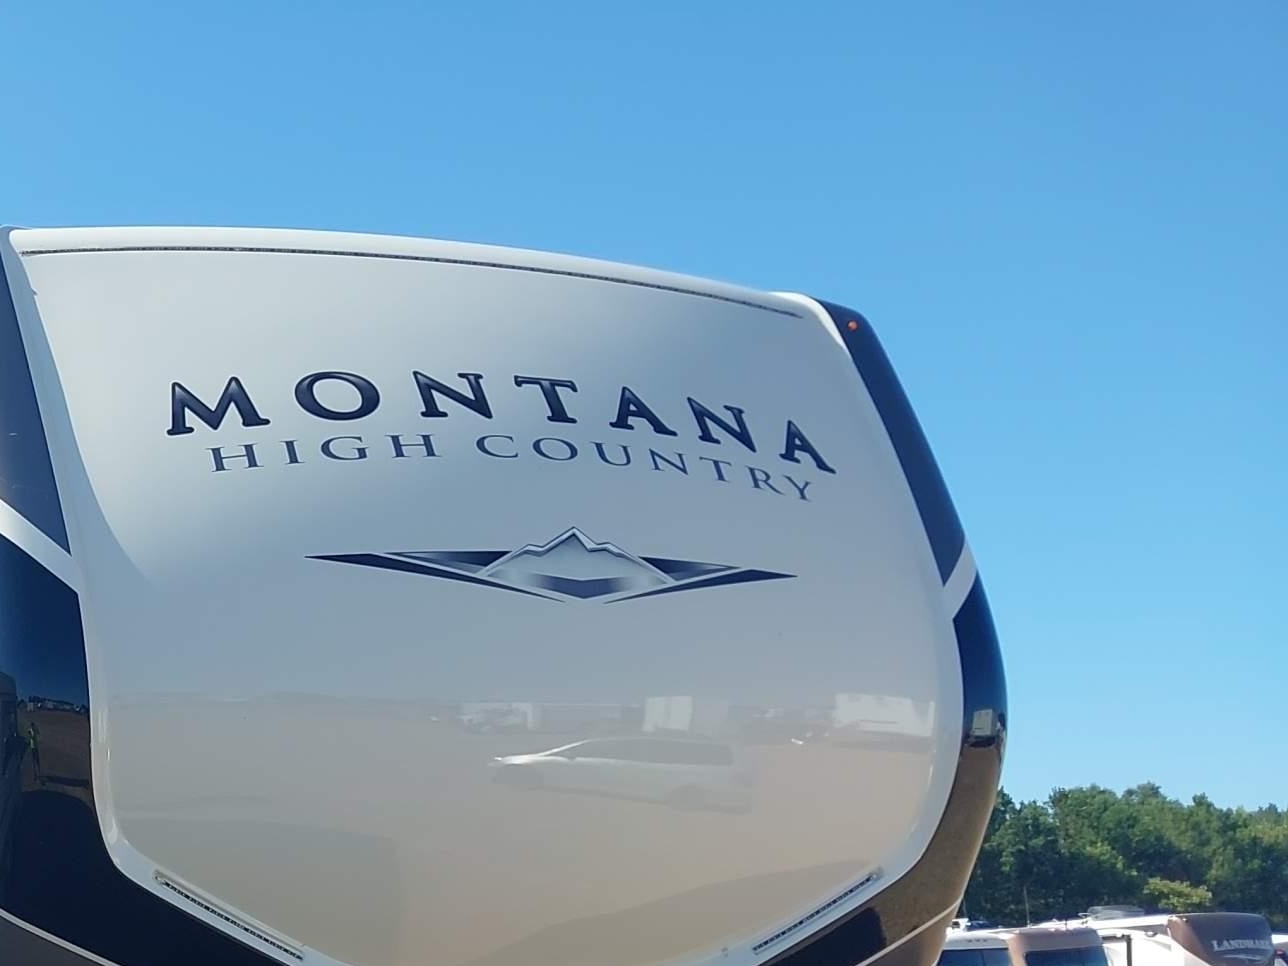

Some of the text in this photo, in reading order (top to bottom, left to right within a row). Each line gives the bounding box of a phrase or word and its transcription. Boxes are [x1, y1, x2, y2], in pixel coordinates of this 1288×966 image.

[167, 370, 837, 475] MONTANA
[205, 432, 811, 501] HIGH COUNTRY
